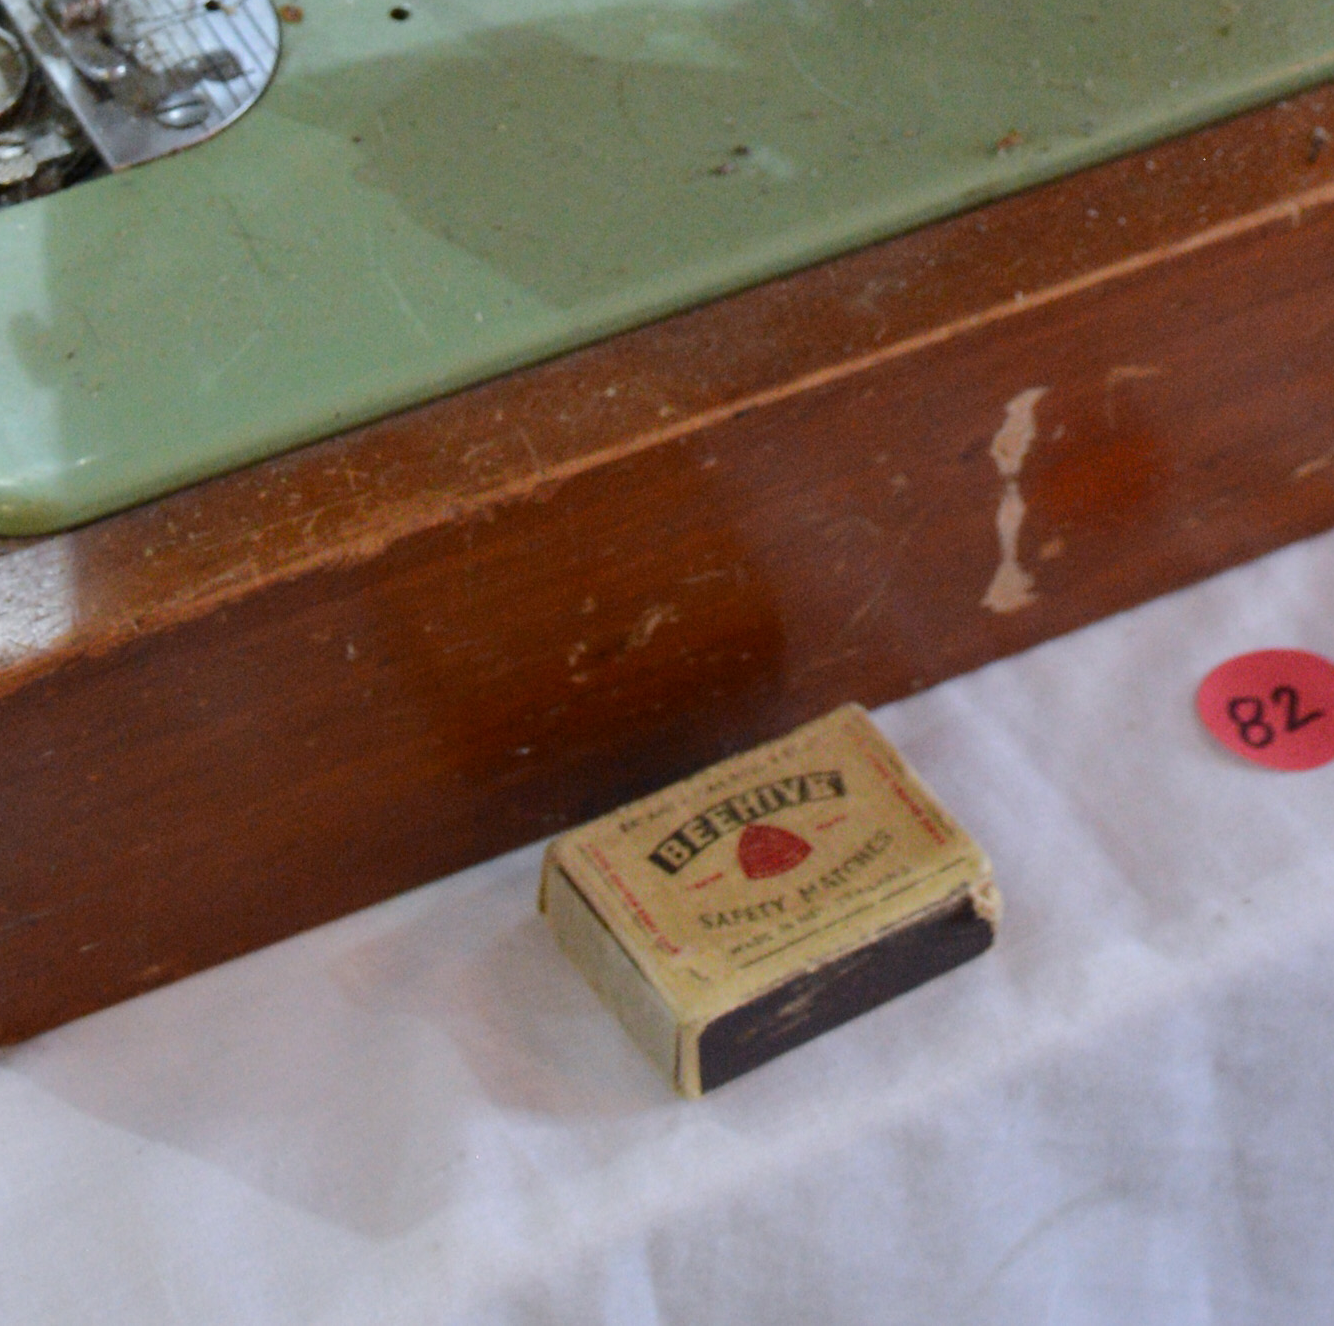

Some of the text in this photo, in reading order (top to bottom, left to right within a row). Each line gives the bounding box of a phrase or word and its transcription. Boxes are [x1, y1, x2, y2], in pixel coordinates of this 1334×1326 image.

[1227, 685, 1324, 749] 82
[651, 771, 844, 871] BEEHIVE
[698, 897, 786, 929] SAFETY
[797, 829, 893, 904] MATCHES
